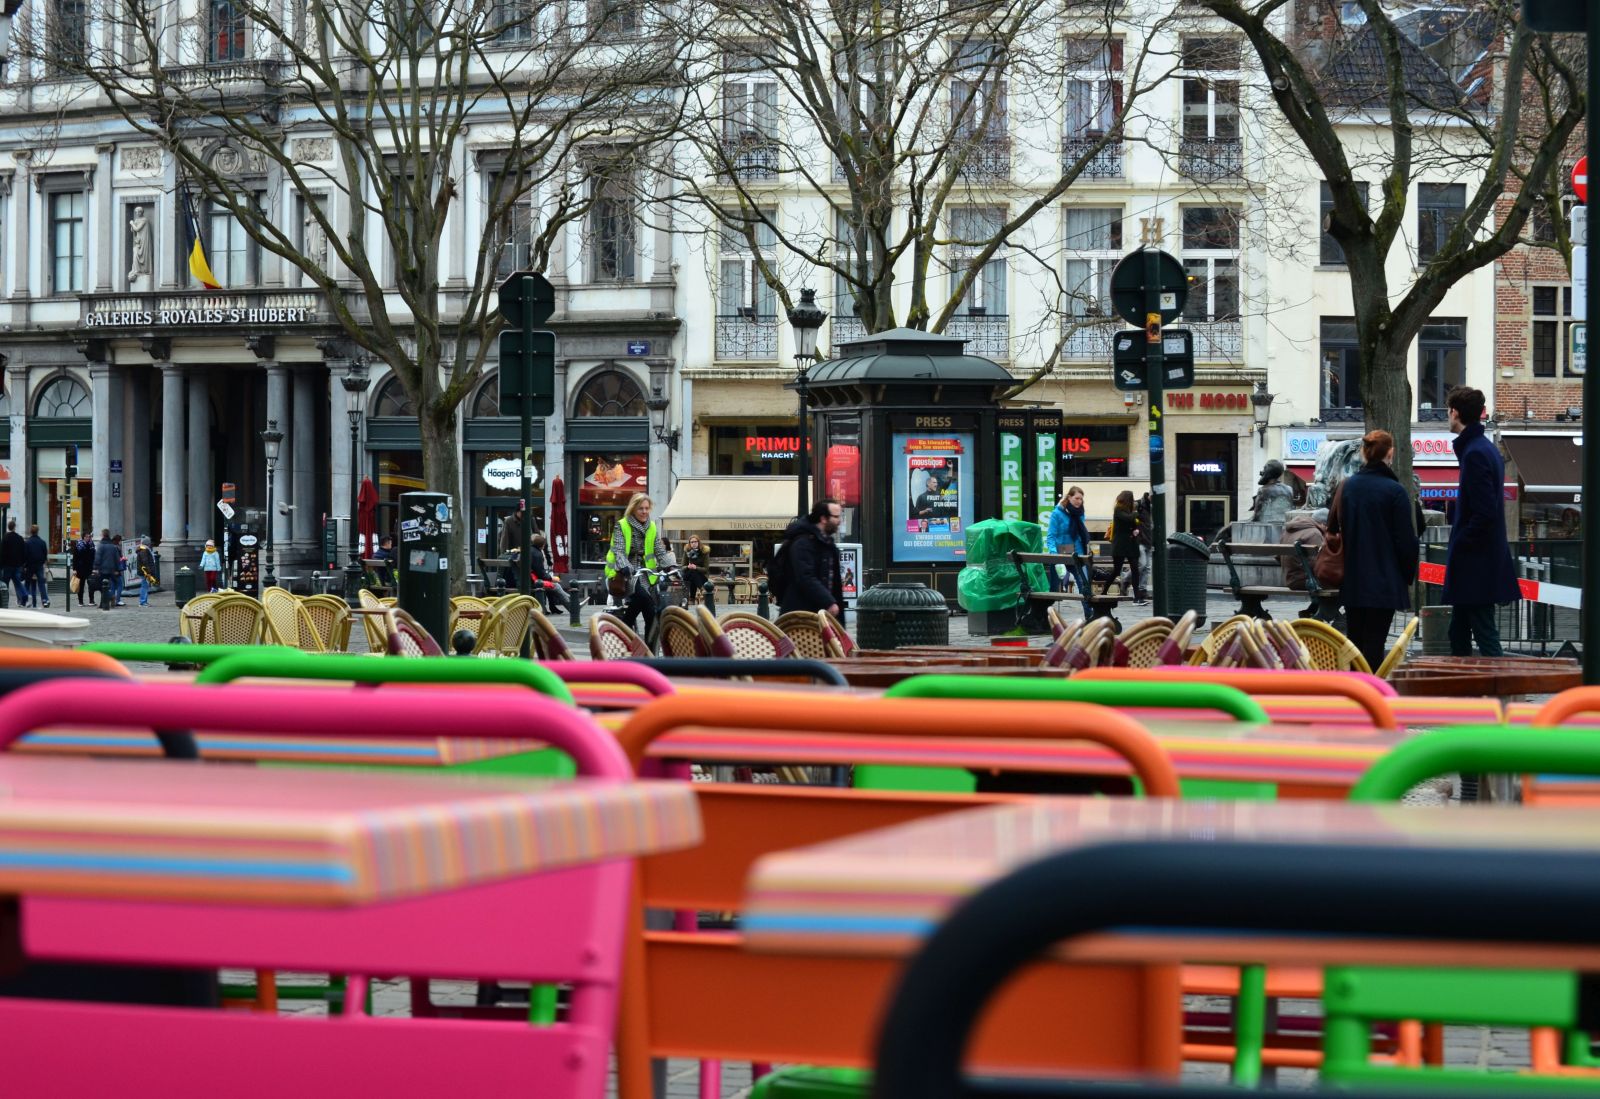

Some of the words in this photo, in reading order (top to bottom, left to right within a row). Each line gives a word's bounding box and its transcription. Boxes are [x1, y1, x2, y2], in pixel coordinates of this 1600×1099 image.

[86, 311, 152, 326] GALERIES
[161, 309, 223, 324] ROYALES
[249, 307, 306, 322] HUBERT
[1167, 393, 1194, 408] THE
[1200, 393, 1248, 408] MOON
[916, 416, 952, 427] PRESS
[999, 418, 1025, 427] PRESS
[1033, 418, 1060, 427] PRESS
[1291, 439, 1318, 452] SOU
[1412, 439, 1453, 453] OCOL
[487, 467, 522, 479] Häagen-D
[1193, 463, 1222, 472] HOTEL
[728, 521, 764, 529] TERRASSE
